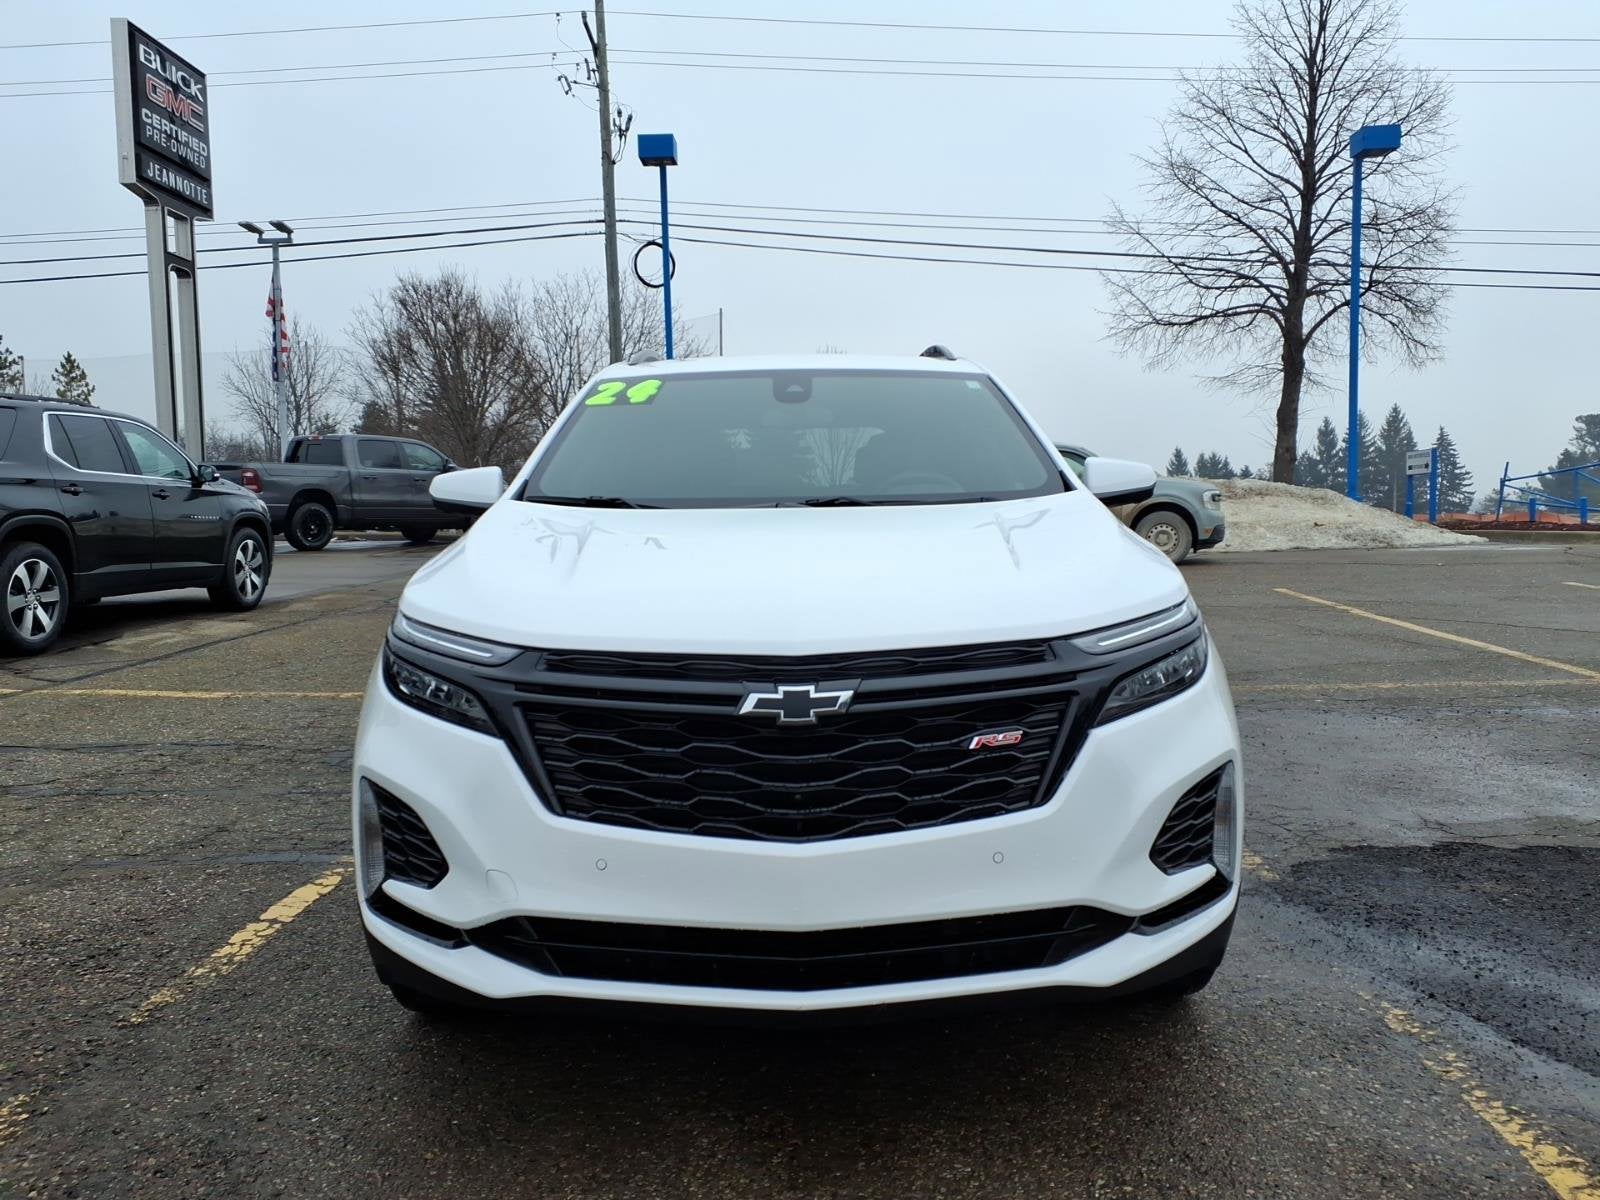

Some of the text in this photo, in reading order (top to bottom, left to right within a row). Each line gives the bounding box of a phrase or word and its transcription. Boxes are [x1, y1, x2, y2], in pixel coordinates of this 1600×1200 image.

[139, 43, 204, 101] BUICK
[145, 73, 204, 132] GMC
[141, 107, 208, 156] CERTIFIED
[146, 127, 206, 168] PRE-OWNED
[147, 161, 208, 204] JEANNOTTE
[585, 379, 662, 405] 24
[969, 730, 1023, 750] RS
